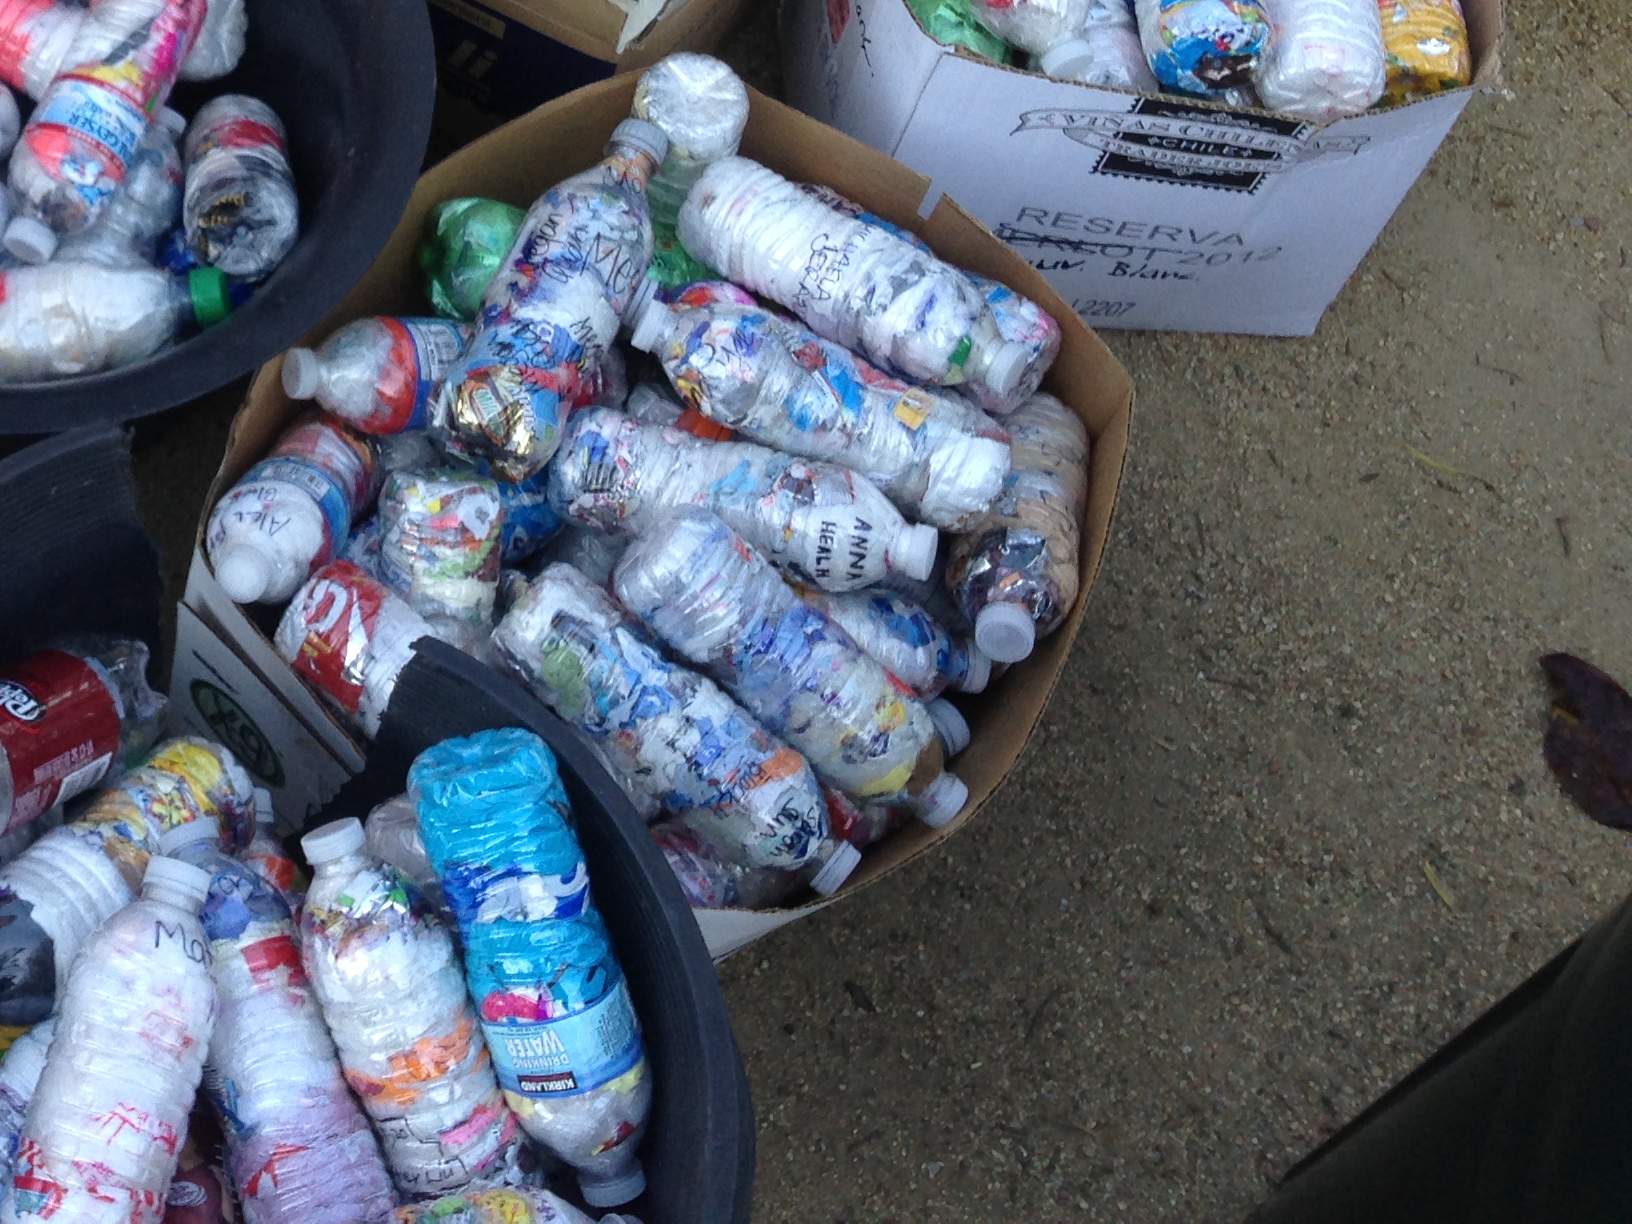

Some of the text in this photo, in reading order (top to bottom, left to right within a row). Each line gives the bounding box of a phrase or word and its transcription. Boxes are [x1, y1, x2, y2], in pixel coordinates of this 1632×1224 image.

[1016, 206, 1244, 247] RESERVA
[846, 516, 873, 582] ANNA
[505, 1029, 565, 1057] WATER
[511, 1052, 570, 1069] DRINKING
[520, 1077, 576, 1092] KIRKLAND
